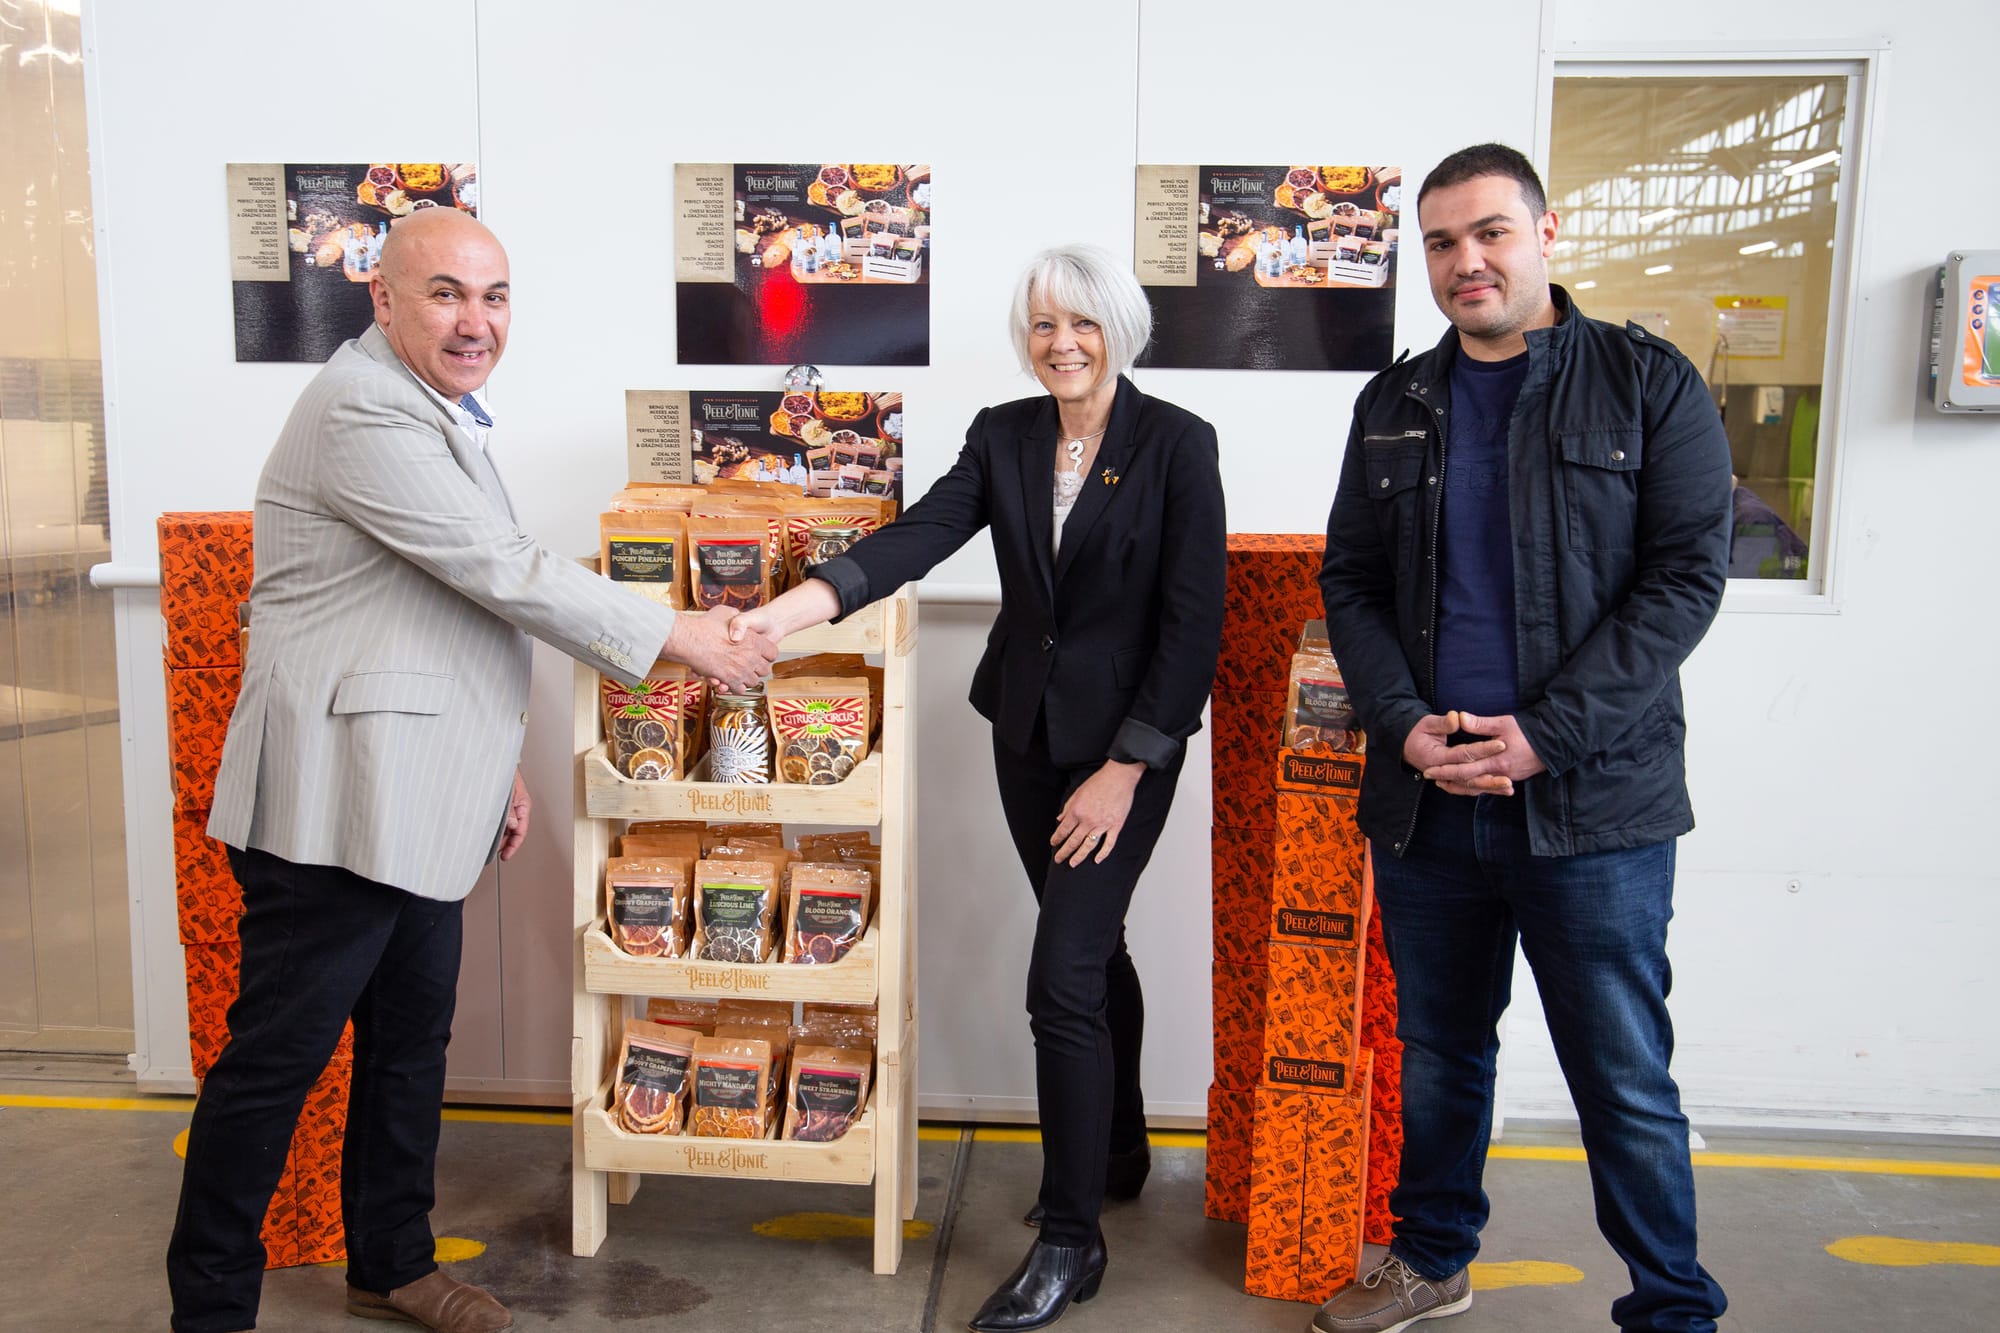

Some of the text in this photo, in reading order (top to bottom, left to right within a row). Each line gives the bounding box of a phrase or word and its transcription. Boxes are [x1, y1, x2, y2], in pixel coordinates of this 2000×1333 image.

[744, 175, 798, 192] PEEL&TONIC
[1210, 177, 1264, 194] PEEL&TONIC
[702, 404, 760, 421] PEEL&TONIC
[638, 555, 672, 563] PINEAPPLE
[608, 694, 669, 705] CITRUS CIRCUS
[1305, 698, 1352, 709] BLOOD ORANG
[784, 712, 854, 724] CITRUS CIRCUS
[1289, 759, 1354, 782] PEEL&TONIC
[688, 788, 772, 816] PEEL&TONIC
[1282, 912, 1348, 935] PEEL&TONIC
[685, 966, 770, 992] PEEL&TONIC
[1274, 1060, 1339, 1082] PEEL&TONIC
[700, 1080, 755, 1090] MIGHTY MANDARIN
[684, 1145, 768, 1171] PEEL&TONIC
